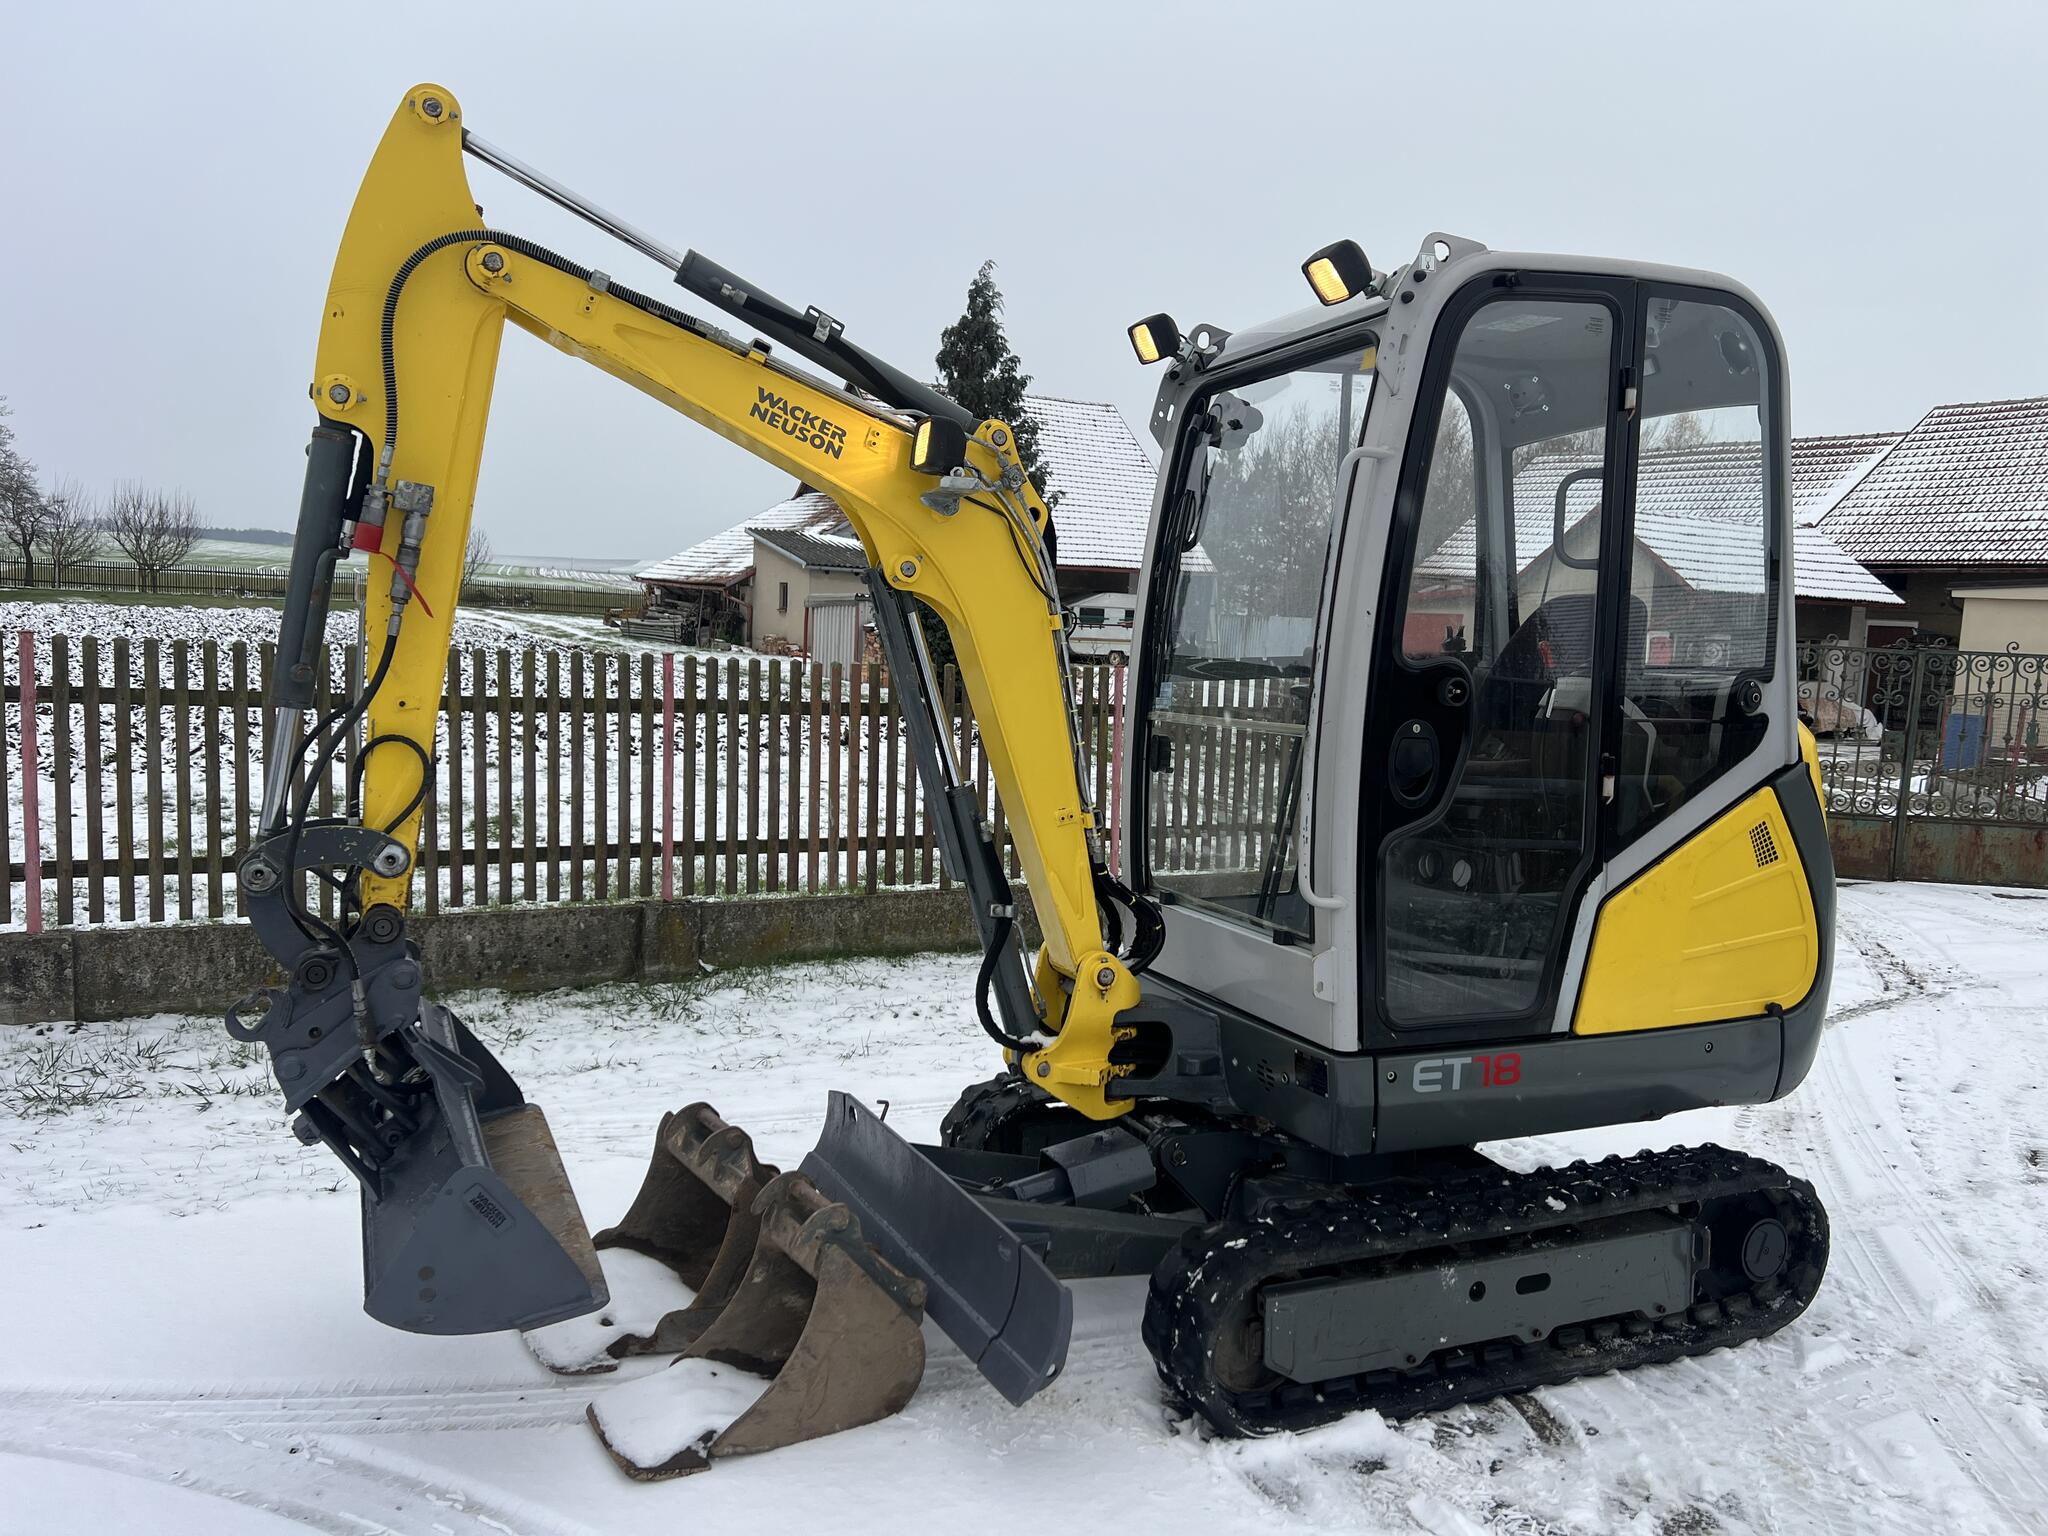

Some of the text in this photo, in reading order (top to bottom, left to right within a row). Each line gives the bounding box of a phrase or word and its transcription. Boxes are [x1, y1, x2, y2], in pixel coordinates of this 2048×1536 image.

[749, 402, 844, 460] NEUSON
[757, 386, 847, 444] WACKER
[1412, 1052, 1521, 1093] ET18
[469, 1197, 502, 1229] NEUSON
[476, 1191, 506, 1222] WACKER
